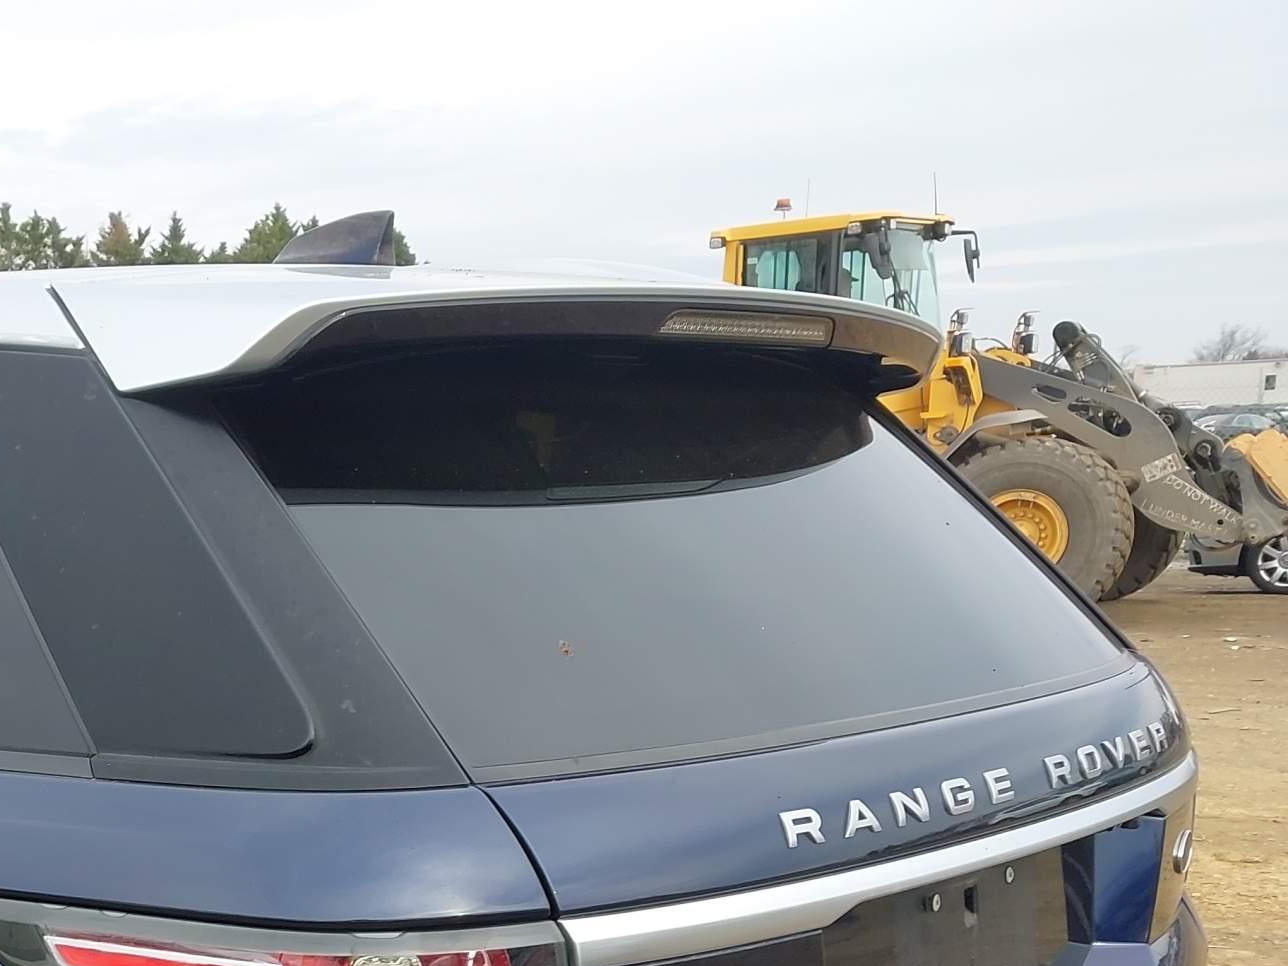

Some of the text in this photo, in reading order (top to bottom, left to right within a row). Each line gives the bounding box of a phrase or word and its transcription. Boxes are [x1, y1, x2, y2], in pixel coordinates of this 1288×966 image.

[1163, 474, 1183, 490] DO
[1183, 482, 1209, 505] NOT
[779, 719, 1170, 848] RANGE ROVER
